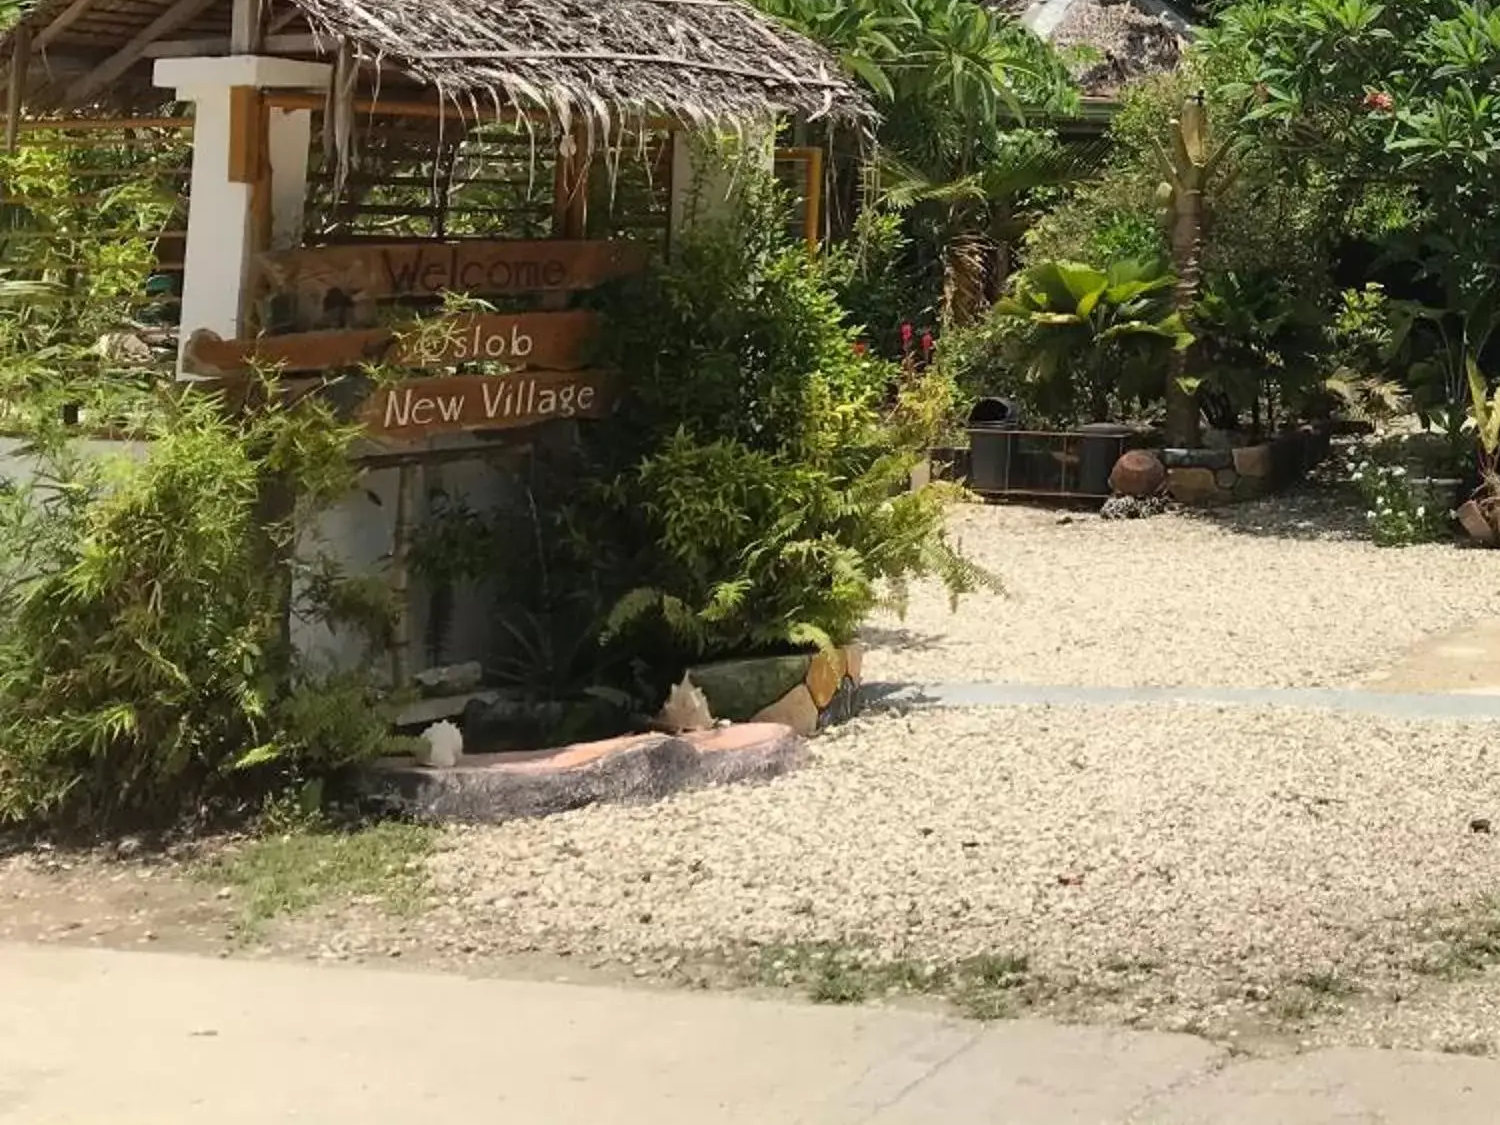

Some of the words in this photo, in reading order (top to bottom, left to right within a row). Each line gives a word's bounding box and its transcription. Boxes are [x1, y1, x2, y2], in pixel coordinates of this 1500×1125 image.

[381, 248, 568, 293] Welcome
[384, 388, 465, 428] New
[482, 379, 595, 419] Village
